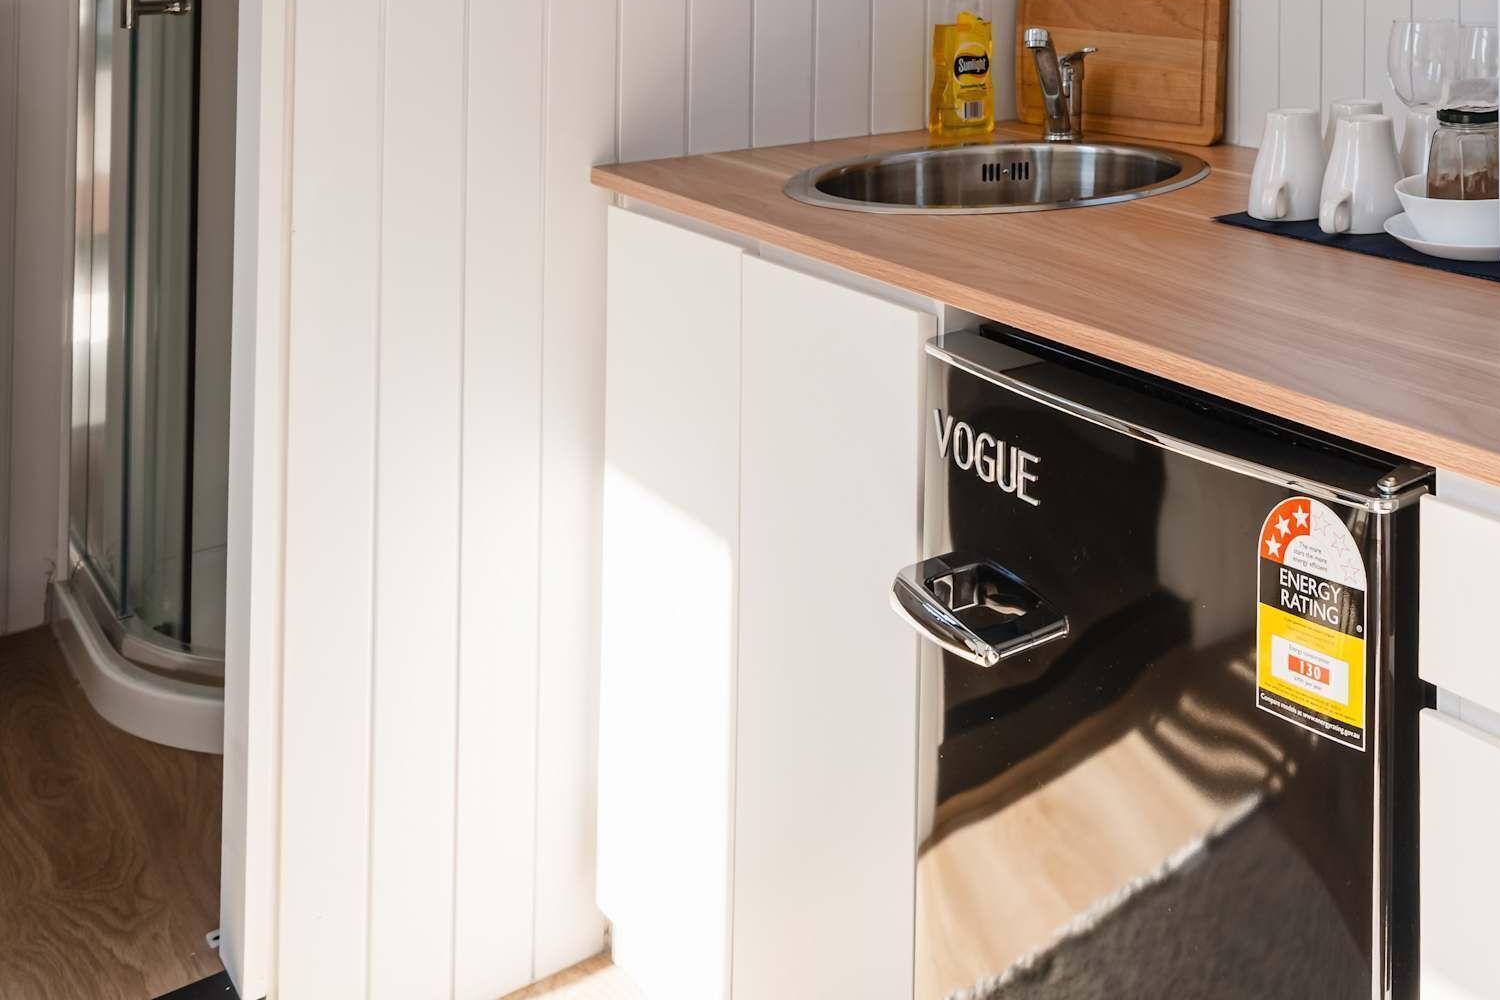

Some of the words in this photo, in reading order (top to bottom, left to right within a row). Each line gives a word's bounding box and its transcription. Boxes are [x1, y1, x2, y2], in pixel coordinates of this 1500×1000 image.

[933, 408, 1041, 506] VOGUE
[1280, 567, 1341, 604] ENERGY
[1280, 588, 1339, 625] RATING
[1300, 659, 1321, 681] 130
[1260, 692, 1281, 707] Compare
